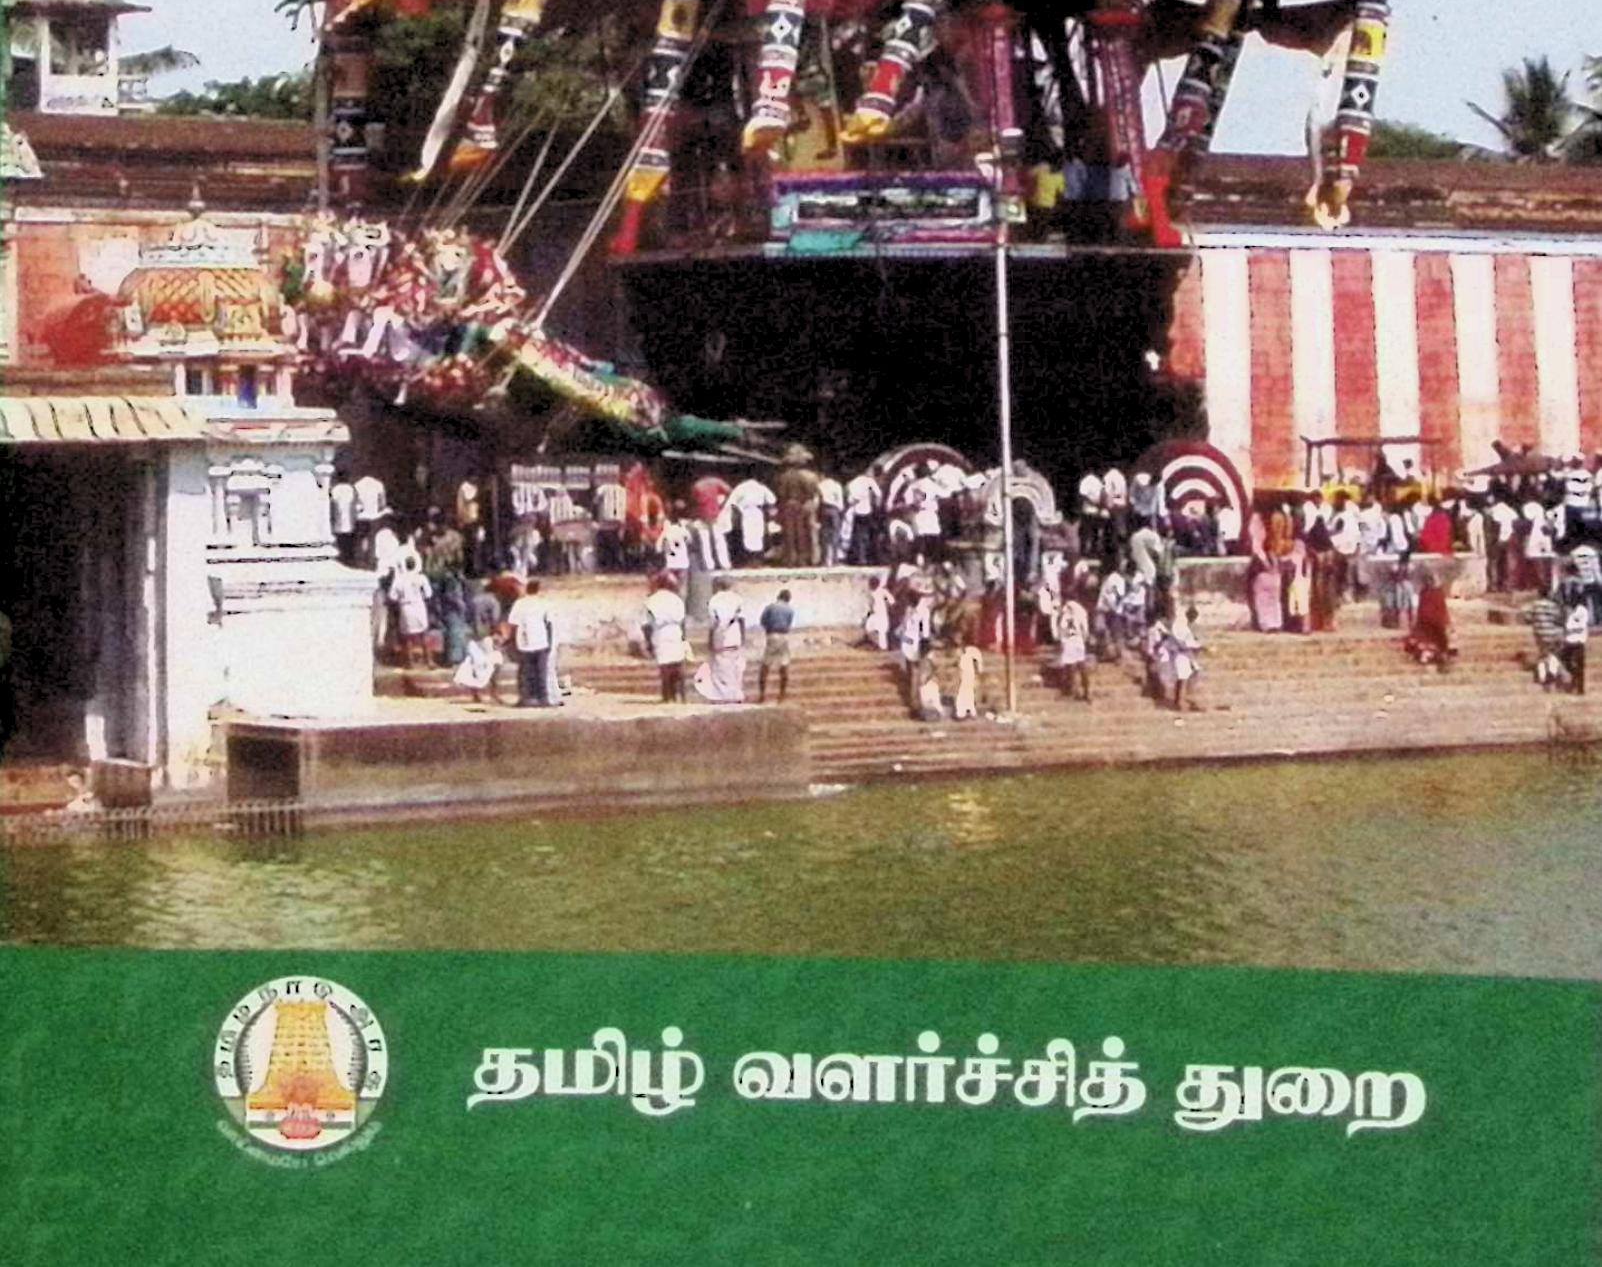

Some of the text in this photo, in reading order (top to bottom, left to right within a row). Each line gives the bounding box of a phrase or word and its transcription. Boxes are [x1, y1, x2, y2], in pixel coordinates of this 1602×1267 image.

[466, 1026, 704, 1116] தமிழ்
[733, 1030, 1147, 1123] வளர்ச்சித்
[1174, 1064, 1427, 1136] துறை
